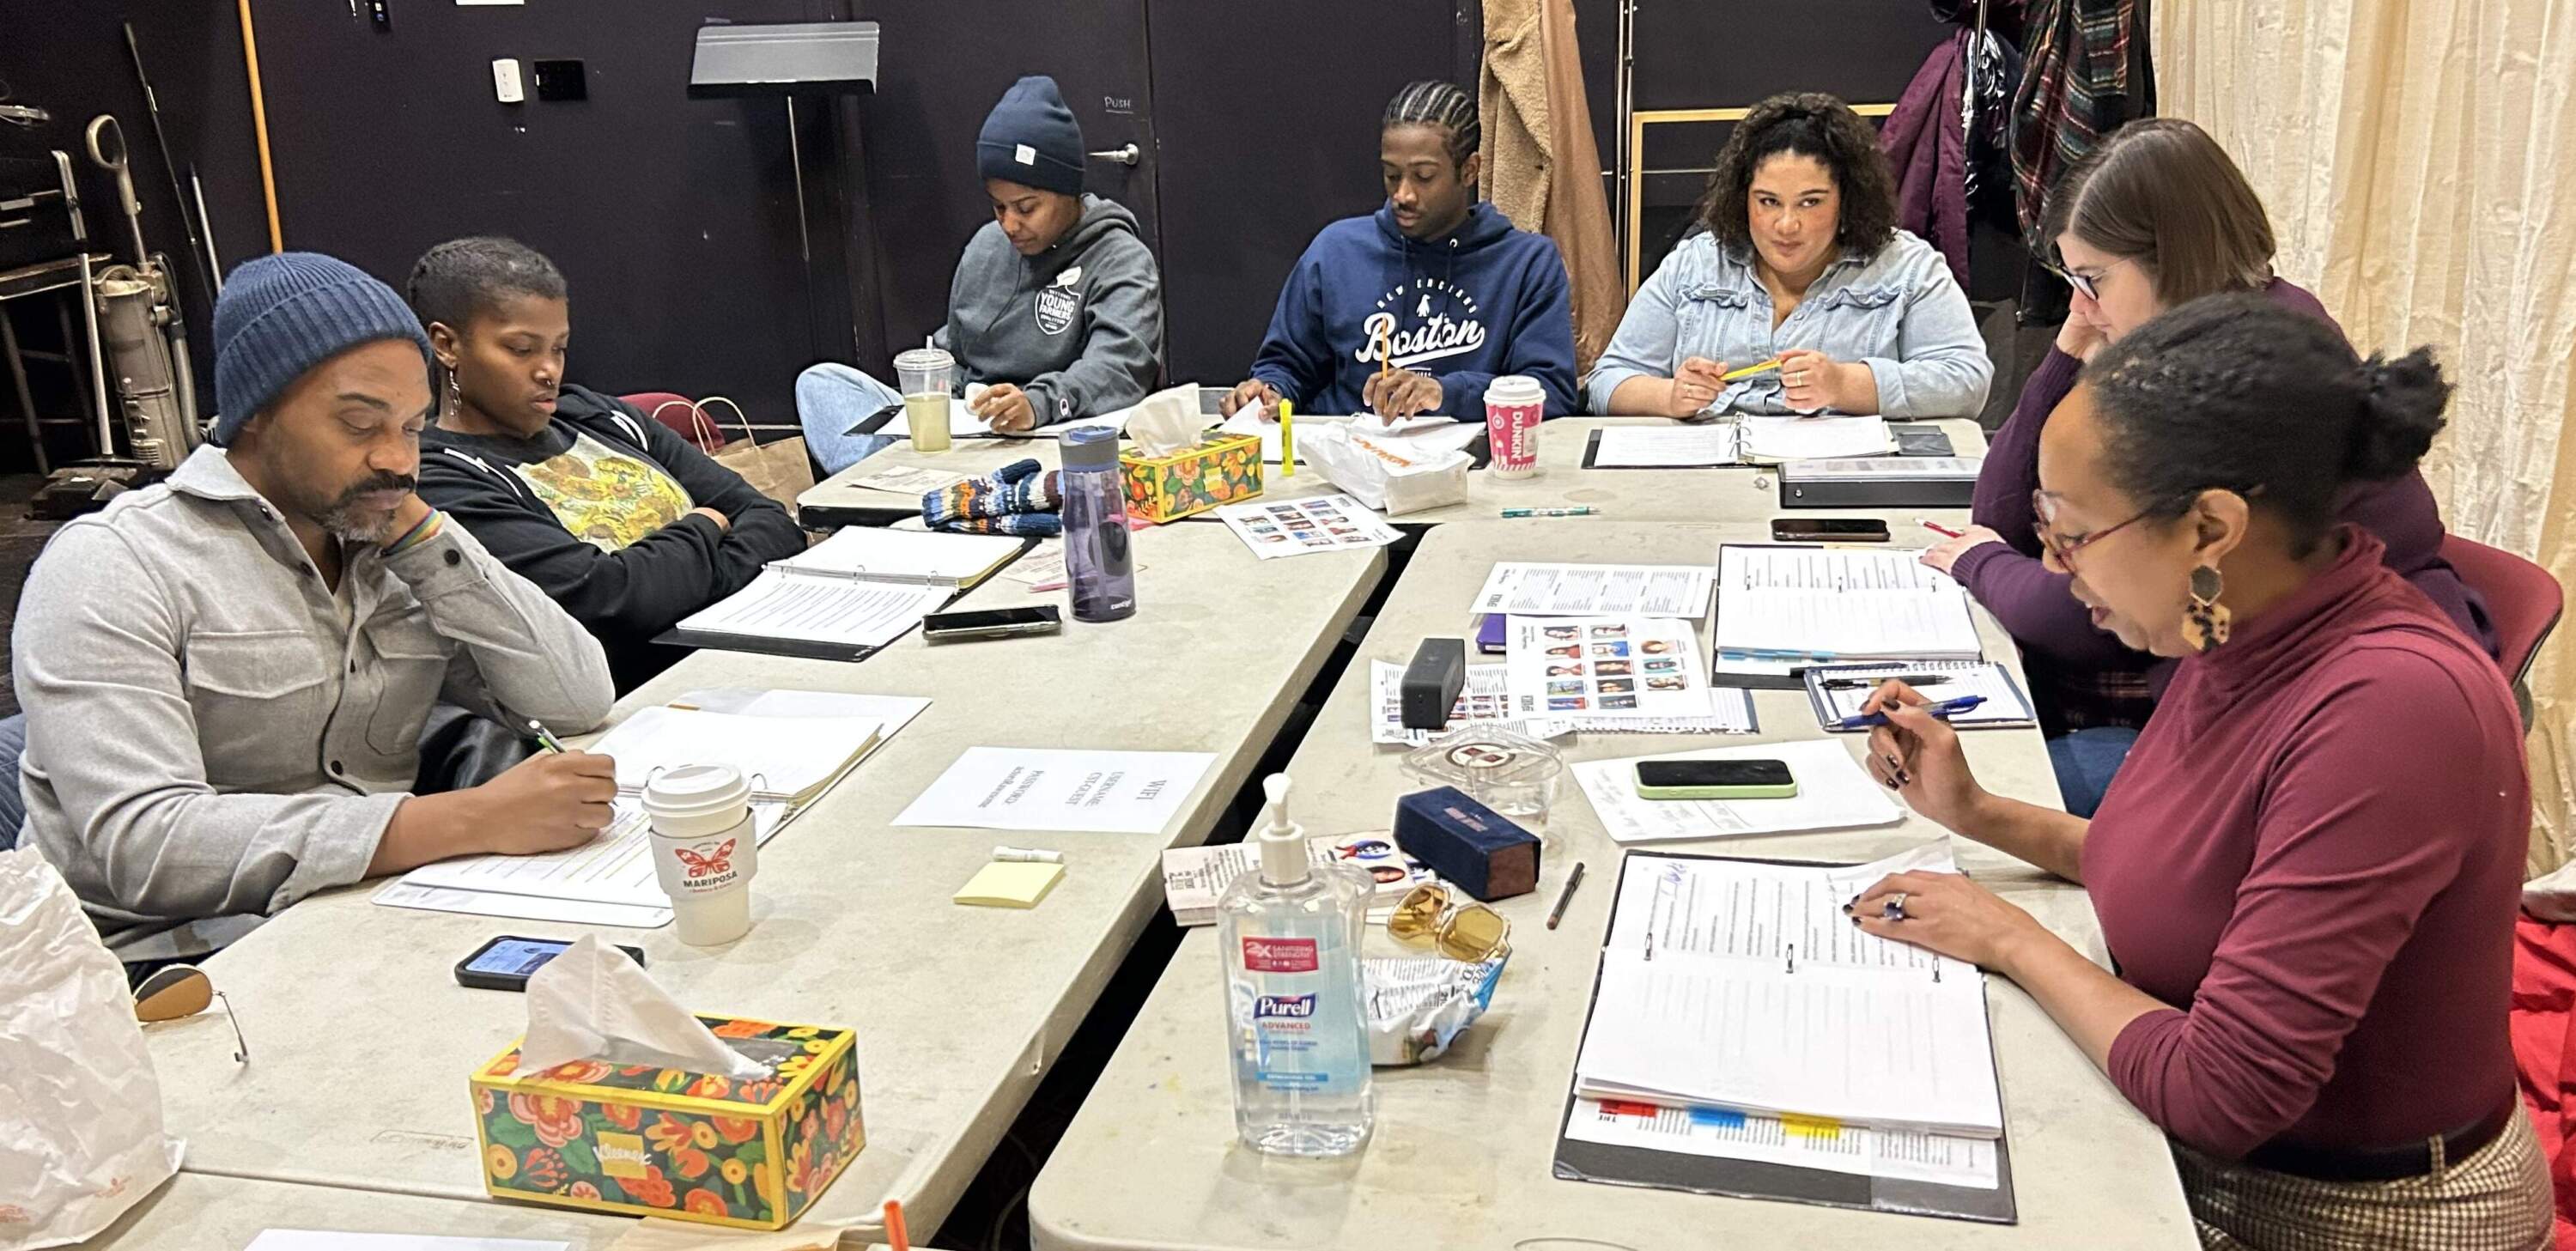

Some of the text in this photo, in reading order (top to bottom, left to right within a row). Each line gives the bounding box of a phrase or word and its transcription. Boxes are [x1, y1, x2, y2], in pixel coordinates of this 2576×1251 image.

[1104, 95, 1131, 109] PUSH
[1041, 292, 1075, 313] YOUNG
[1376, 277, 1477, 314] NEW ENGLAND
[1038, 303, 1072, 320] FARMERS
[1354, 312, 1485, 364] Boston
[1135, 780, 1167, 800] WIFI
[683, 871, 738, 888] MARIPOSA
[1245, 941, 1273, 958] 2X
[1260, 997, 1311, 1016] Purell
[1262, 1021, 1310, 1029] ADVANCED
[592, 1142, 653, 1166] Kleenex
